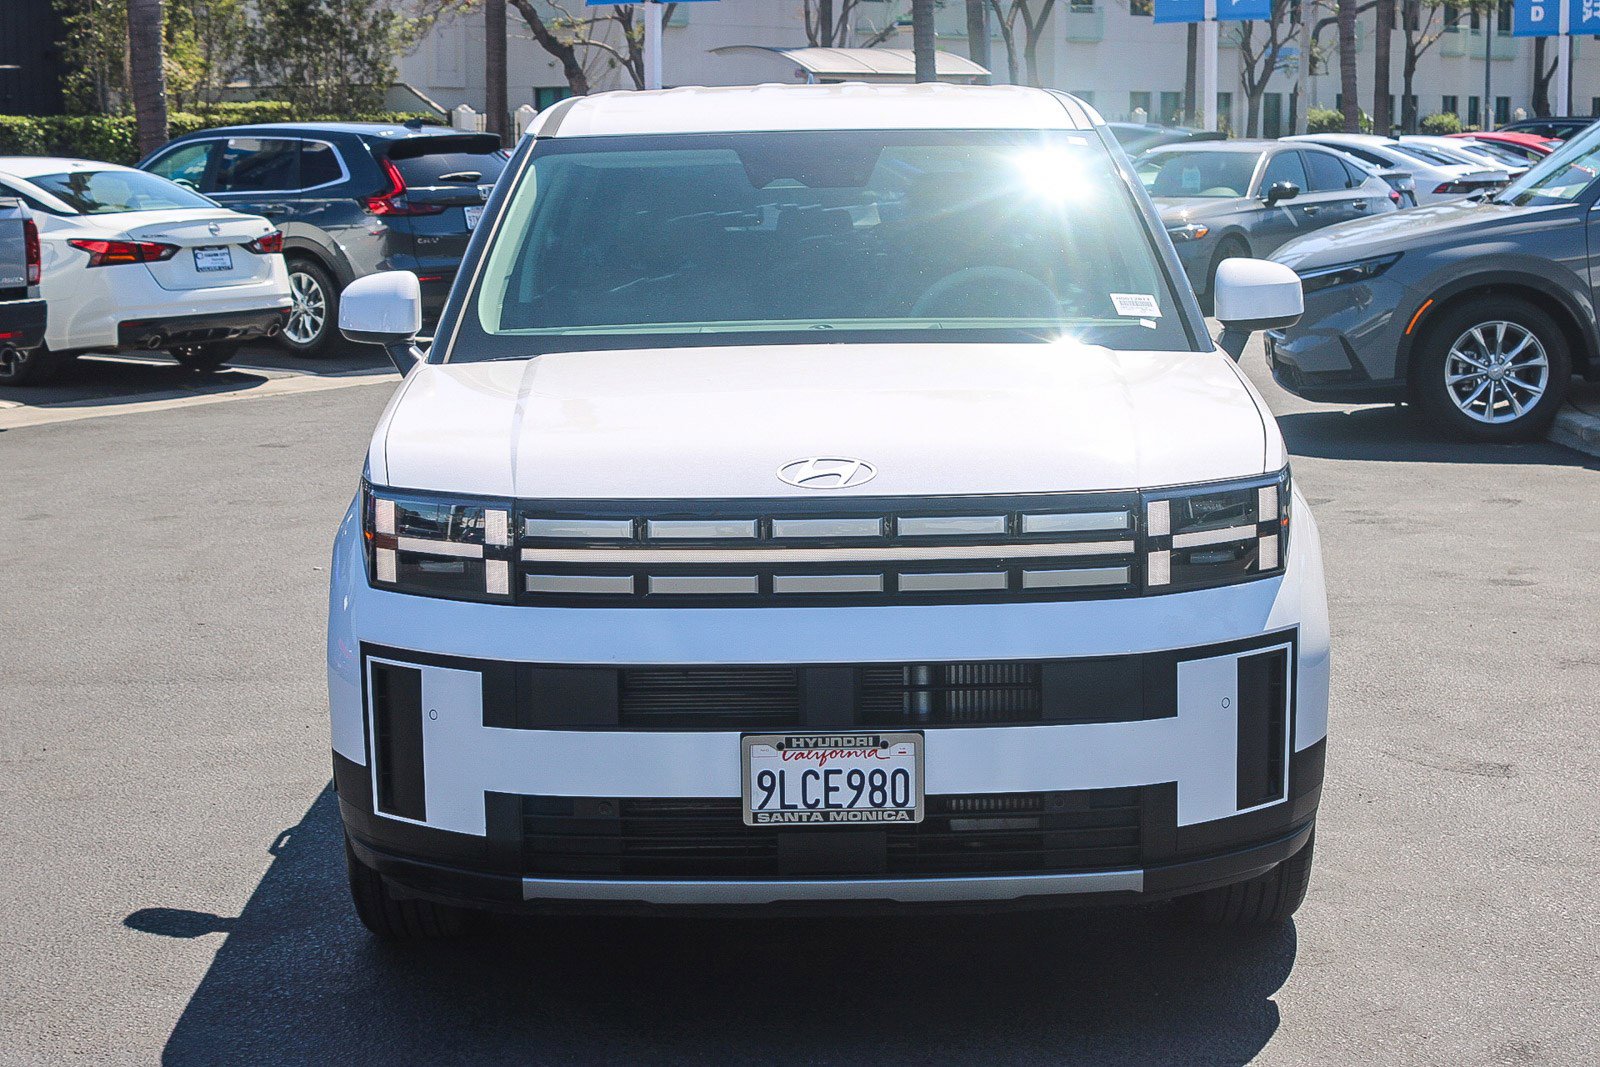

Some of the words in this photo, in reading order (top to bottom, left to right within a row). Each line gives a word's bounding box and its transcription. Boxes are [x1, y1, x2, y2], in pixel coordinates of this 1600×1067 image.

[792, 736, 873, 747] HYUNDAI
[782, 748, 890, 767] California
[757, 768, 910, 810] 9LCE980
[757, 811, 824, 823] SANTA
[829, 810, 910, 822] MONICA
